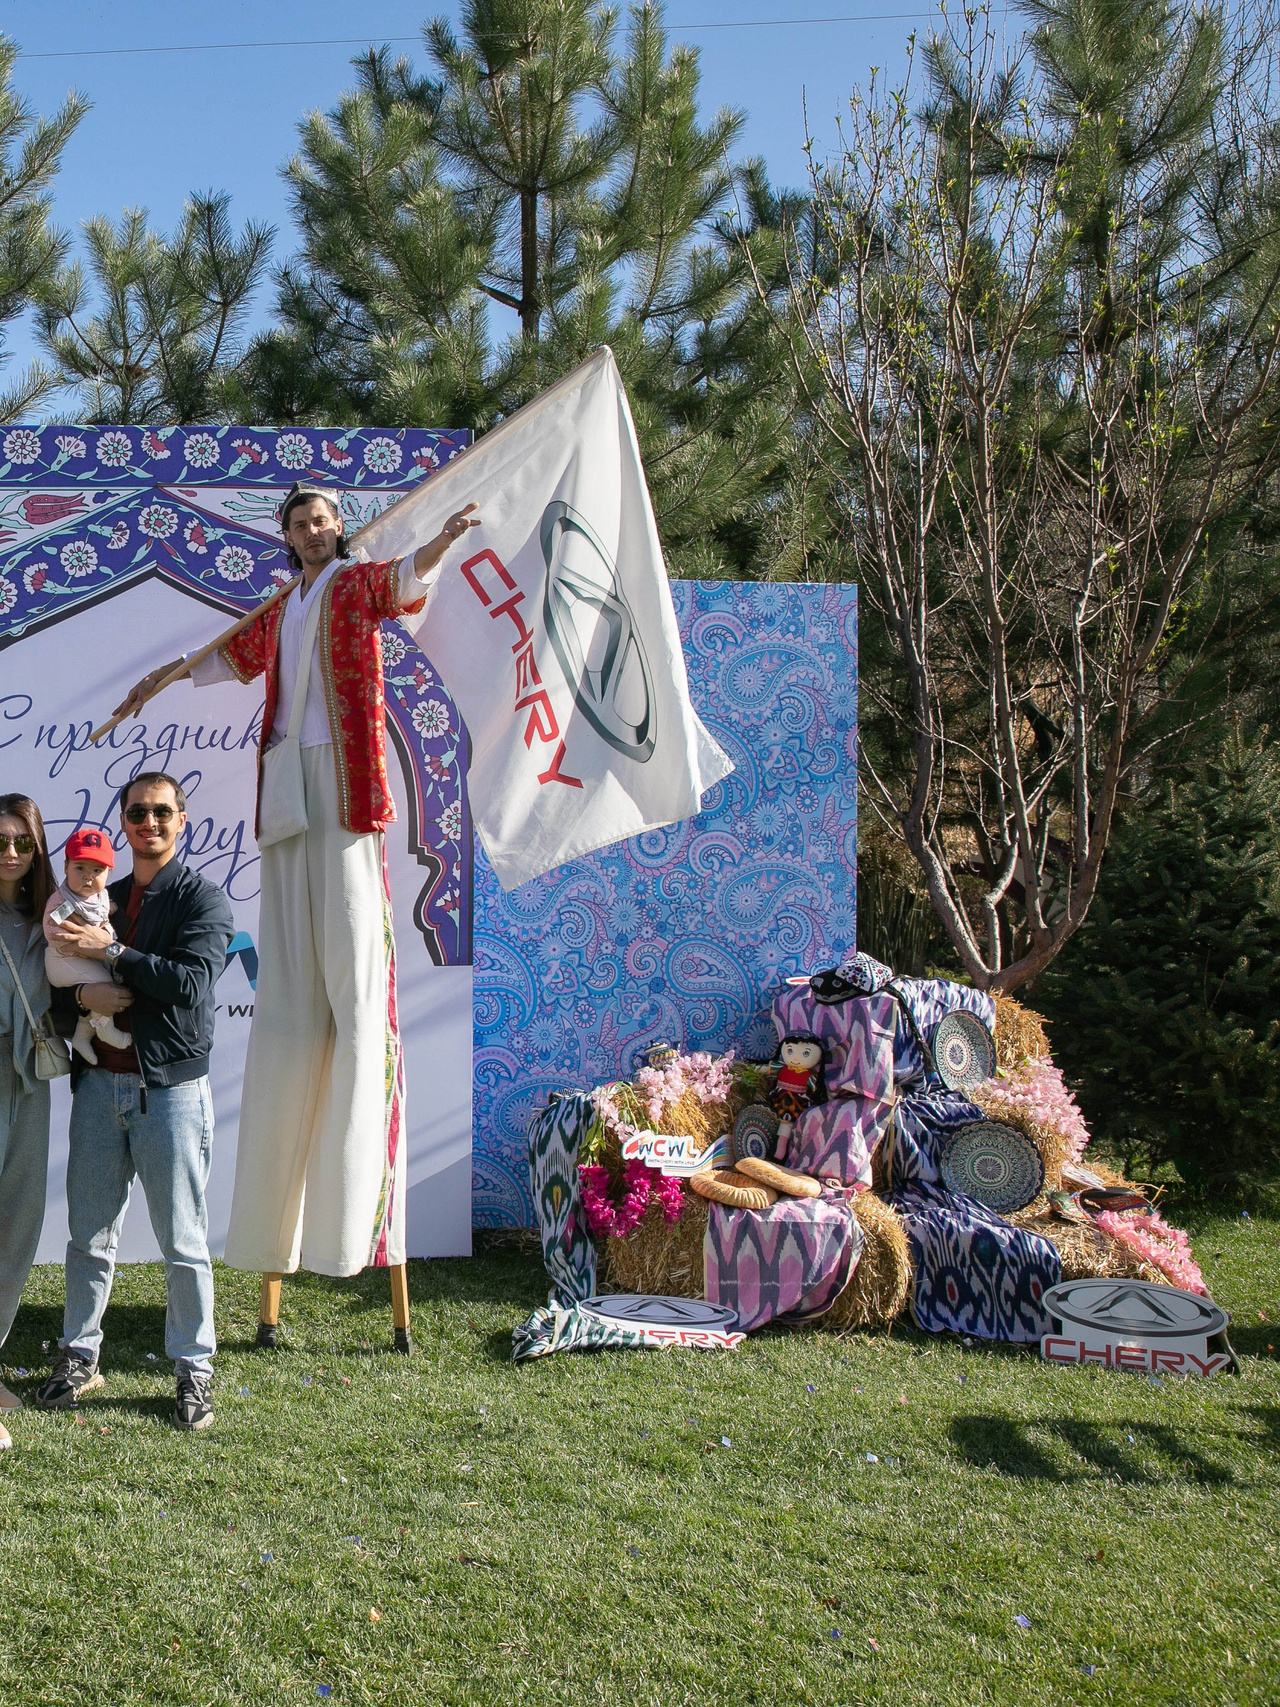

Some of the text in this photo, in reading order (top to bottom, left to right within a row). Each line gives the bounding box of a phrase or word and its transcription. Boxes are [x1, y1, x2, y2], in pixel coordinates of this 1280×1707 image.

[460, 548, 584, 789] CHERY
[34, 699, 266, 788] праздник
[87, 833, 102, 848] G
[227, 1004, 255, 1018] WI
[640, 1329, 741, 1346] ERY
[1044, 1337, 1226, 1378] CHERY
